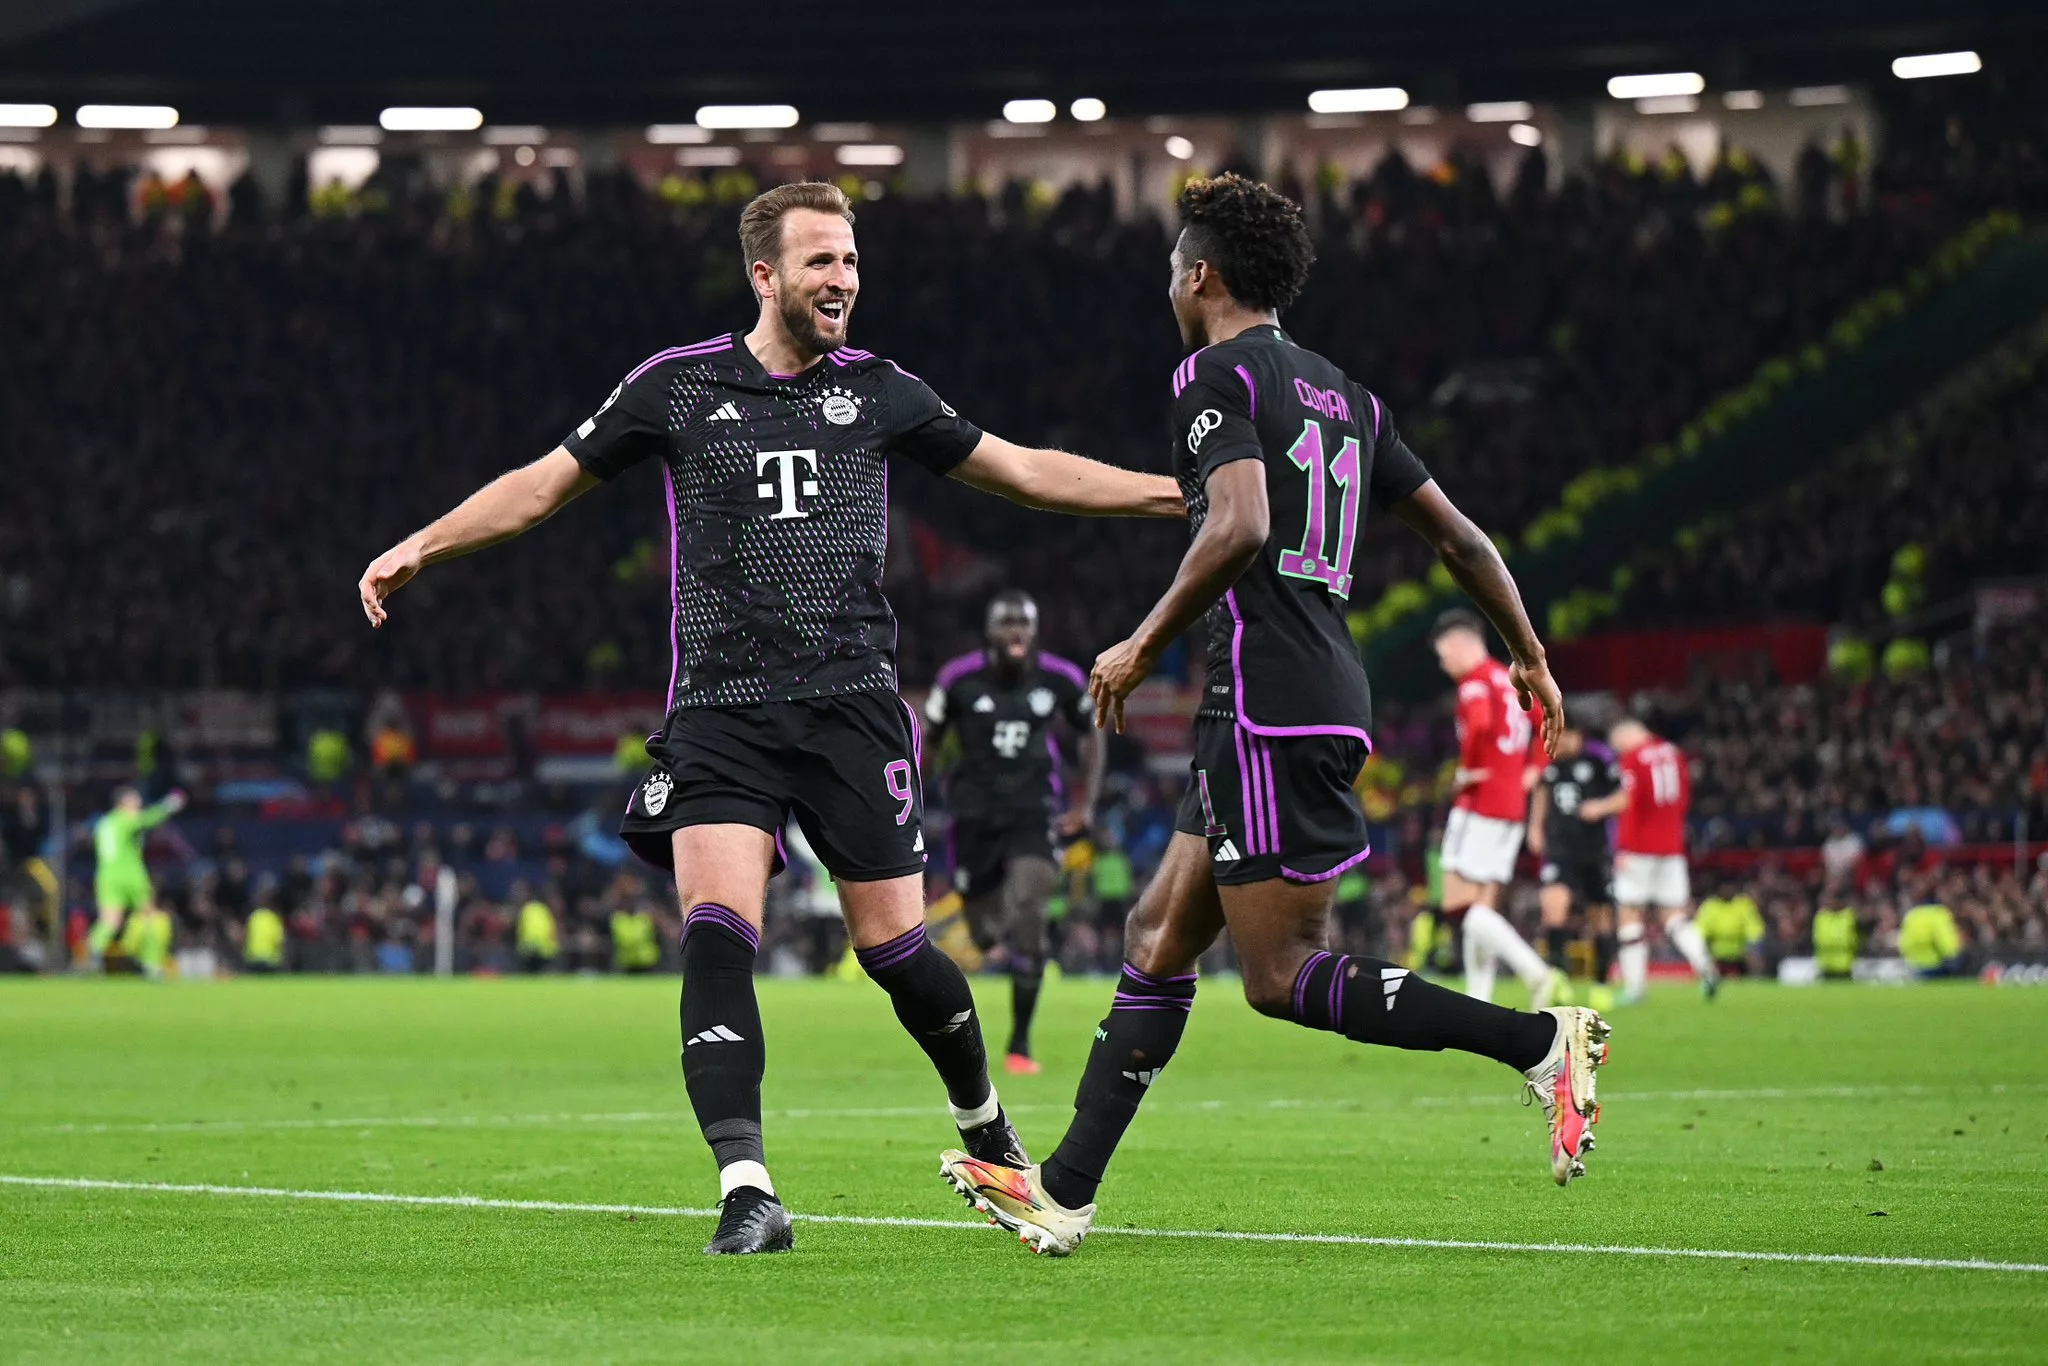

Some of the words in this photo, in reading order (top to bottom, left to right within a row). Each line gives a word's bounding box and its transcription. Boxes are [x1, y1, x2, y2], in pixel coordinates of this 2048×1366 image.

[1293, 378, 1354, 424] COMAN
[756, 449, 819, 521] T
[1277, 418, 1361, 601] 11
[883, 759, 914, 826] 9
